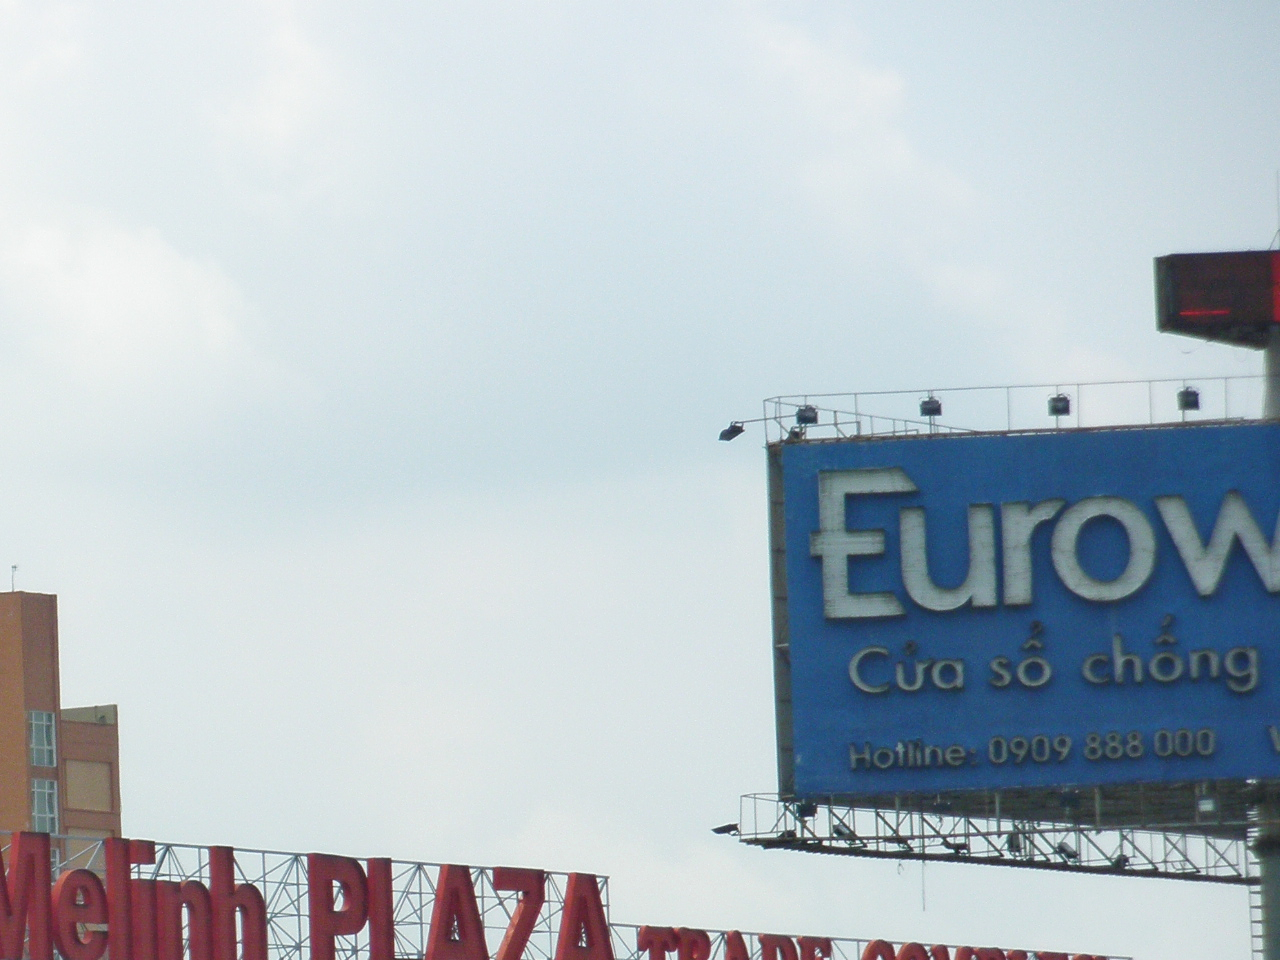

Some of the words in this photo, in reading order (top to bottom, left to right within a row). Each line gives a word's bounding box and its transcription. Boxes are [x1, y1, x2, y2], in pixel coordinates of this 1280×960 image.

[848, 640, 965, 694] Cửa
[989, 621, 1053, 687] sổ
[1082, 615, 1261, 694] chống
[988, 734, 1073, 765] 0909
[1083, 730, 1144, 761] 888
[1153, 727, 1216, 757] 000
